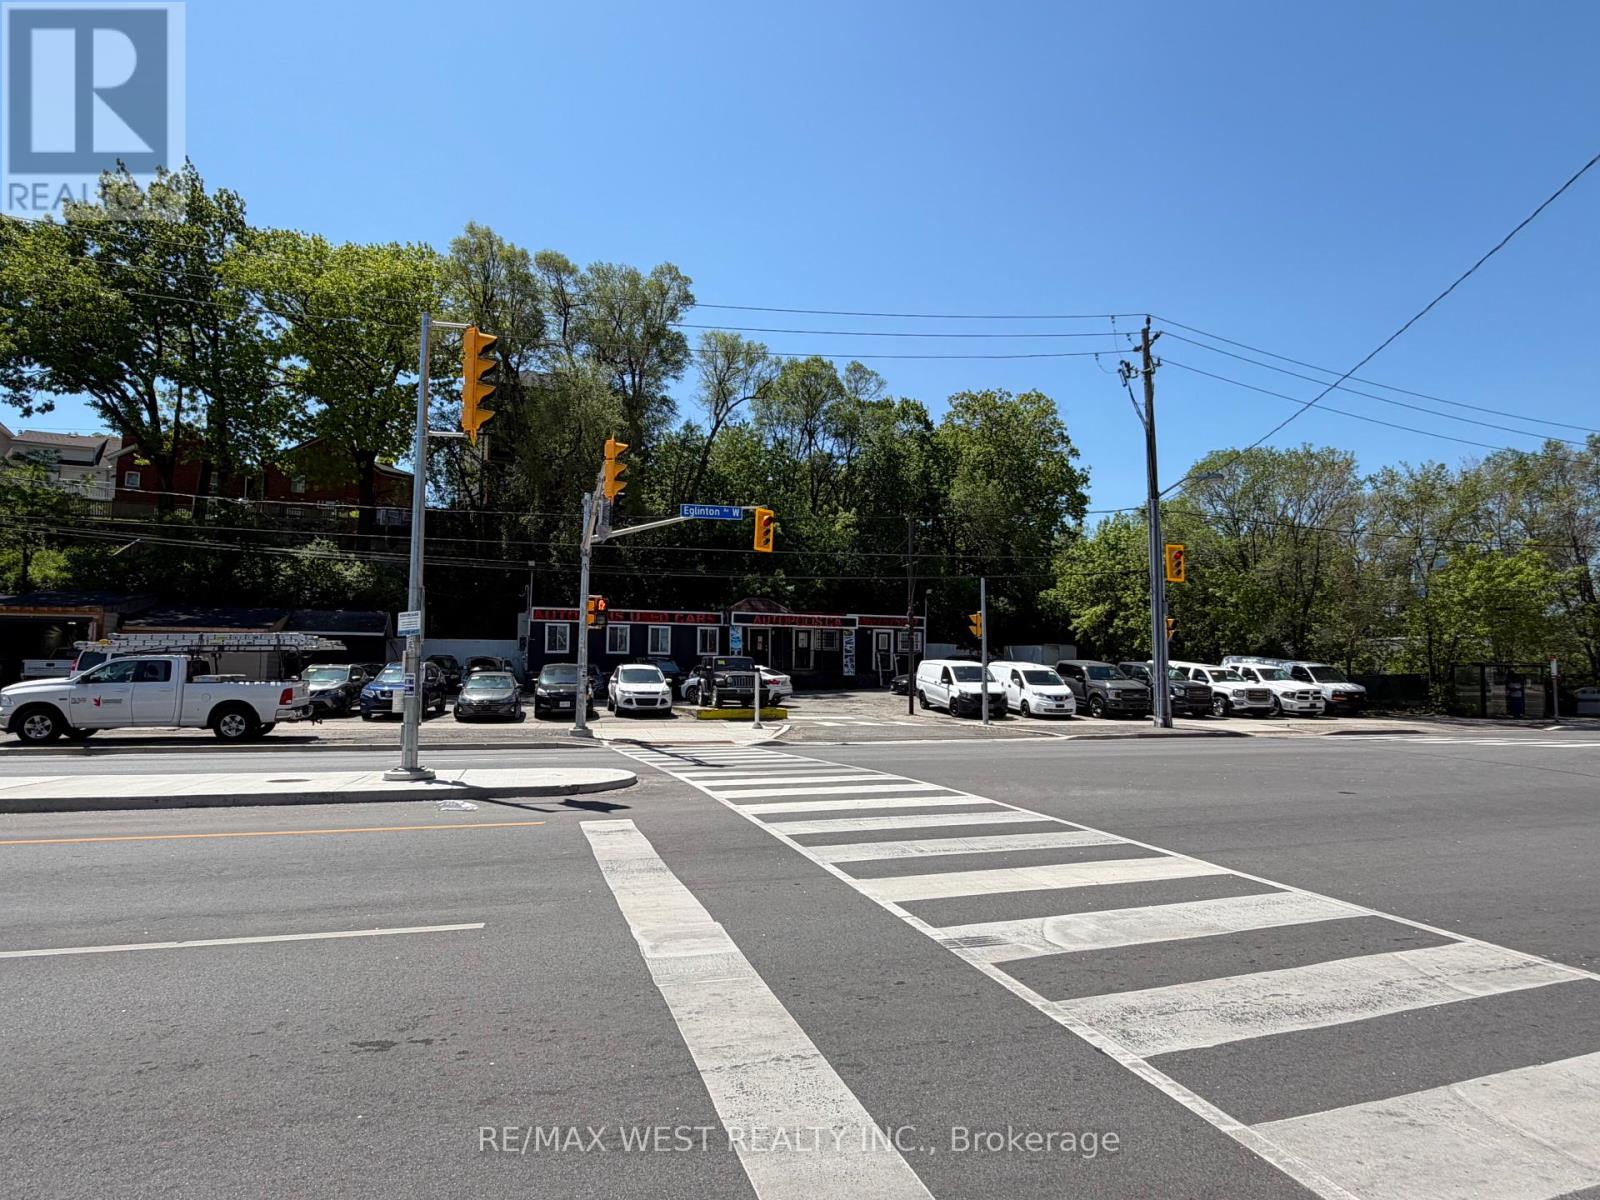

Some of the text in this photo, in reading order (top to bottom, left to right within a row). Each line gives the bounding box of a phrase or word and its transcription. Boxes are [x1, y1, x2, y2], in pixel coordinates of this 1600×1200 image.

[683, 506, 720, 517] Eglinton
[732, 509, 740, 517] W
[630, 611, 668, 624] USED
[674, 613, 717, 625] CARS
